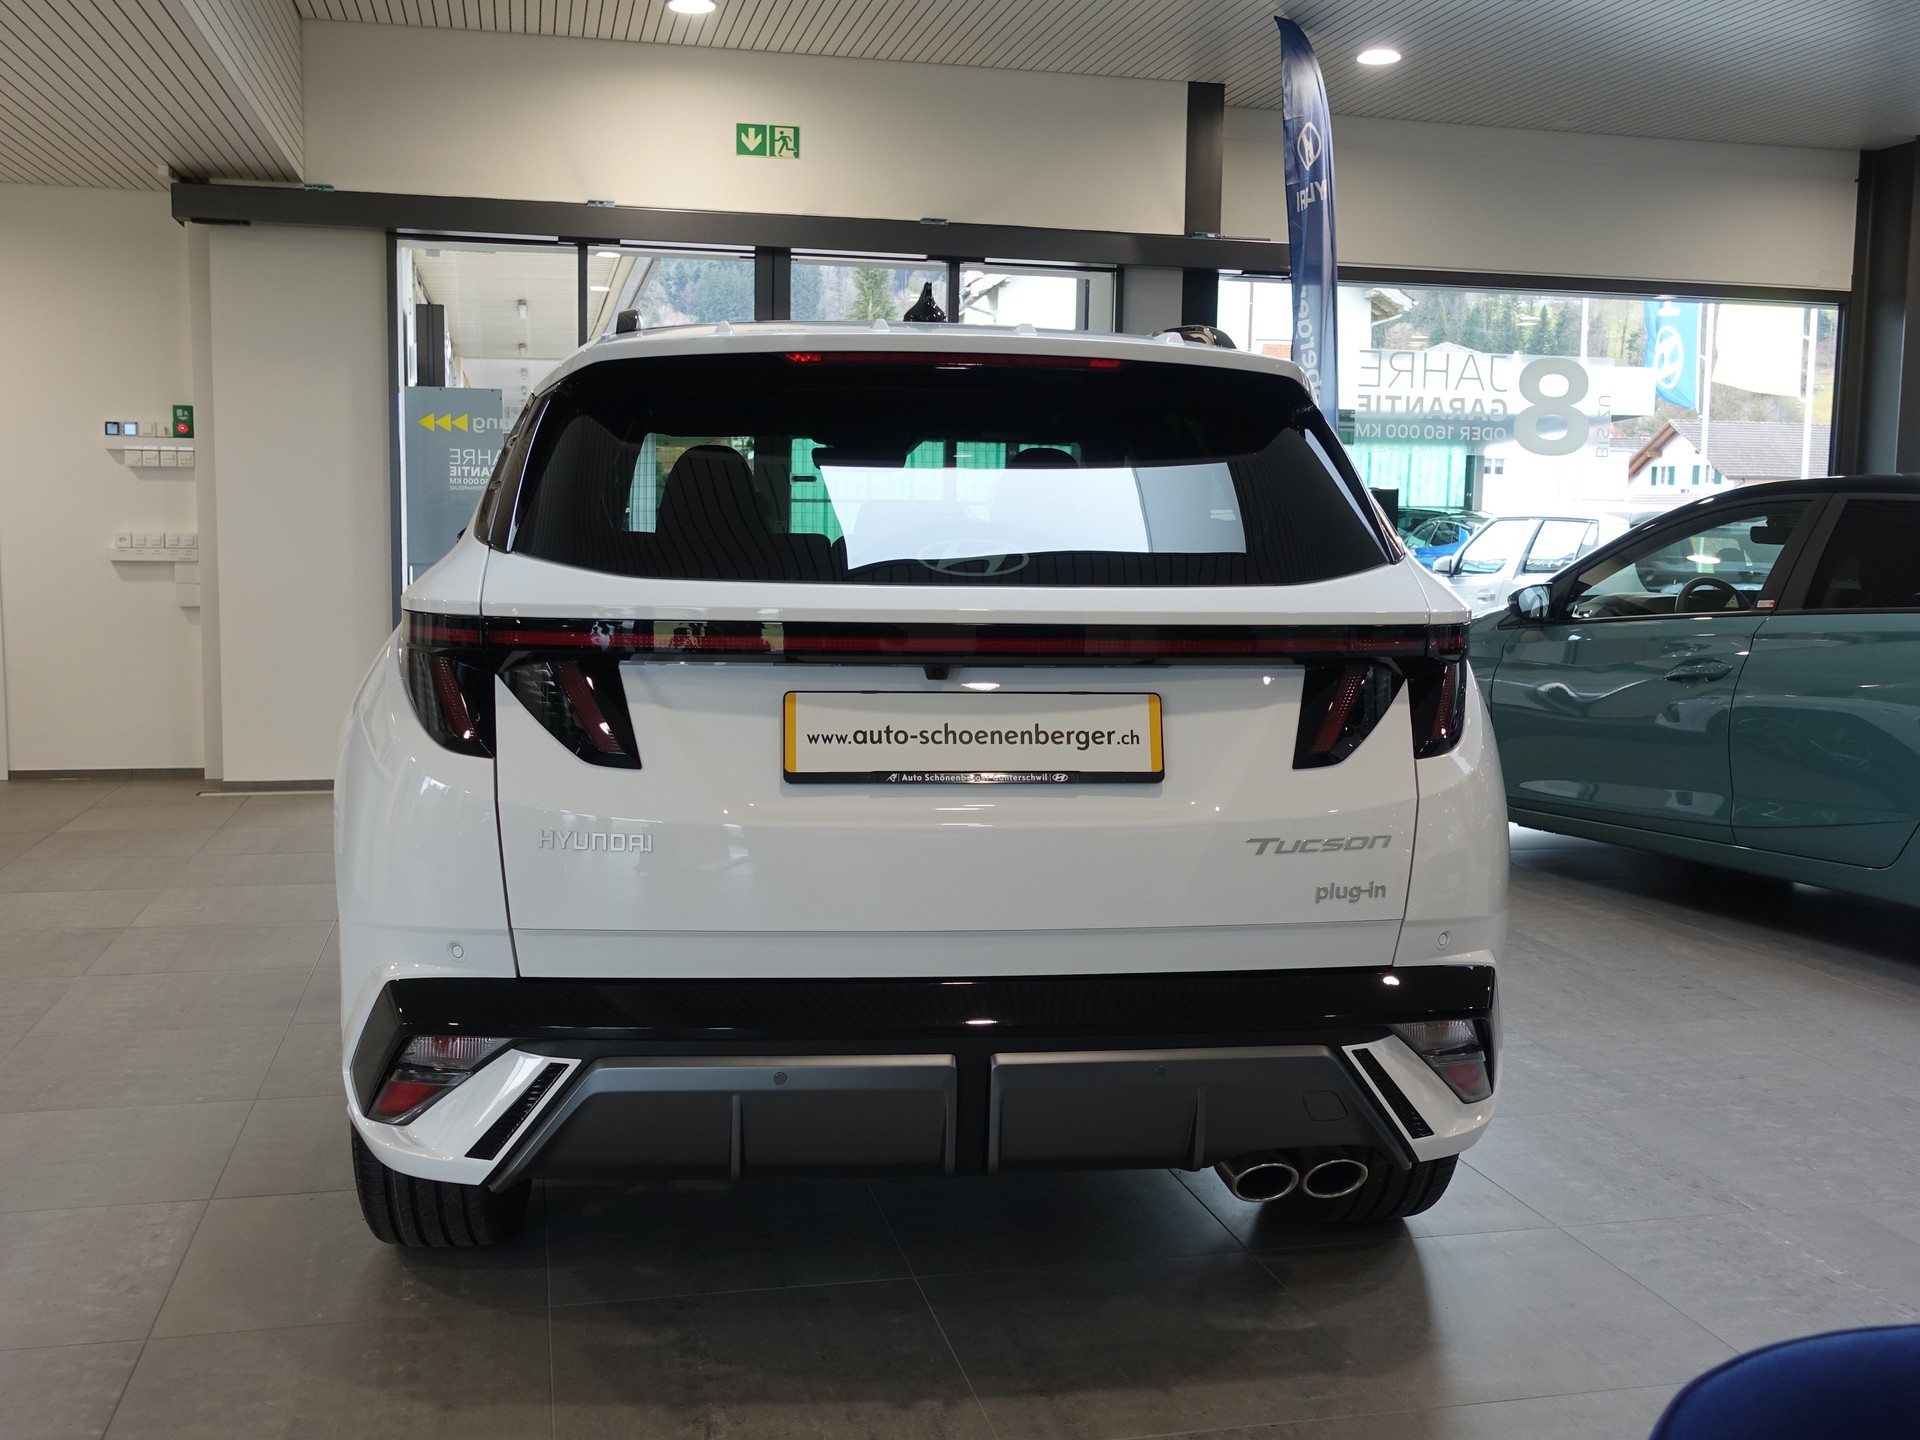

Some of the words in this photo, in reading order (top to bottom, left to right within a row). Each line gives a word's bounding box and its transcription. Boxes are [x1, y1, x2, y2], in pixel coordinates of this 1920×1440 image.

[806, 722, 1141, 751] www.auto-schoenenberger.ch
[901, 773, 923, 782] Auto
[538, 830, 654, 853] HYUNDAI
[1315, 881, 1386, 904] plug-in
